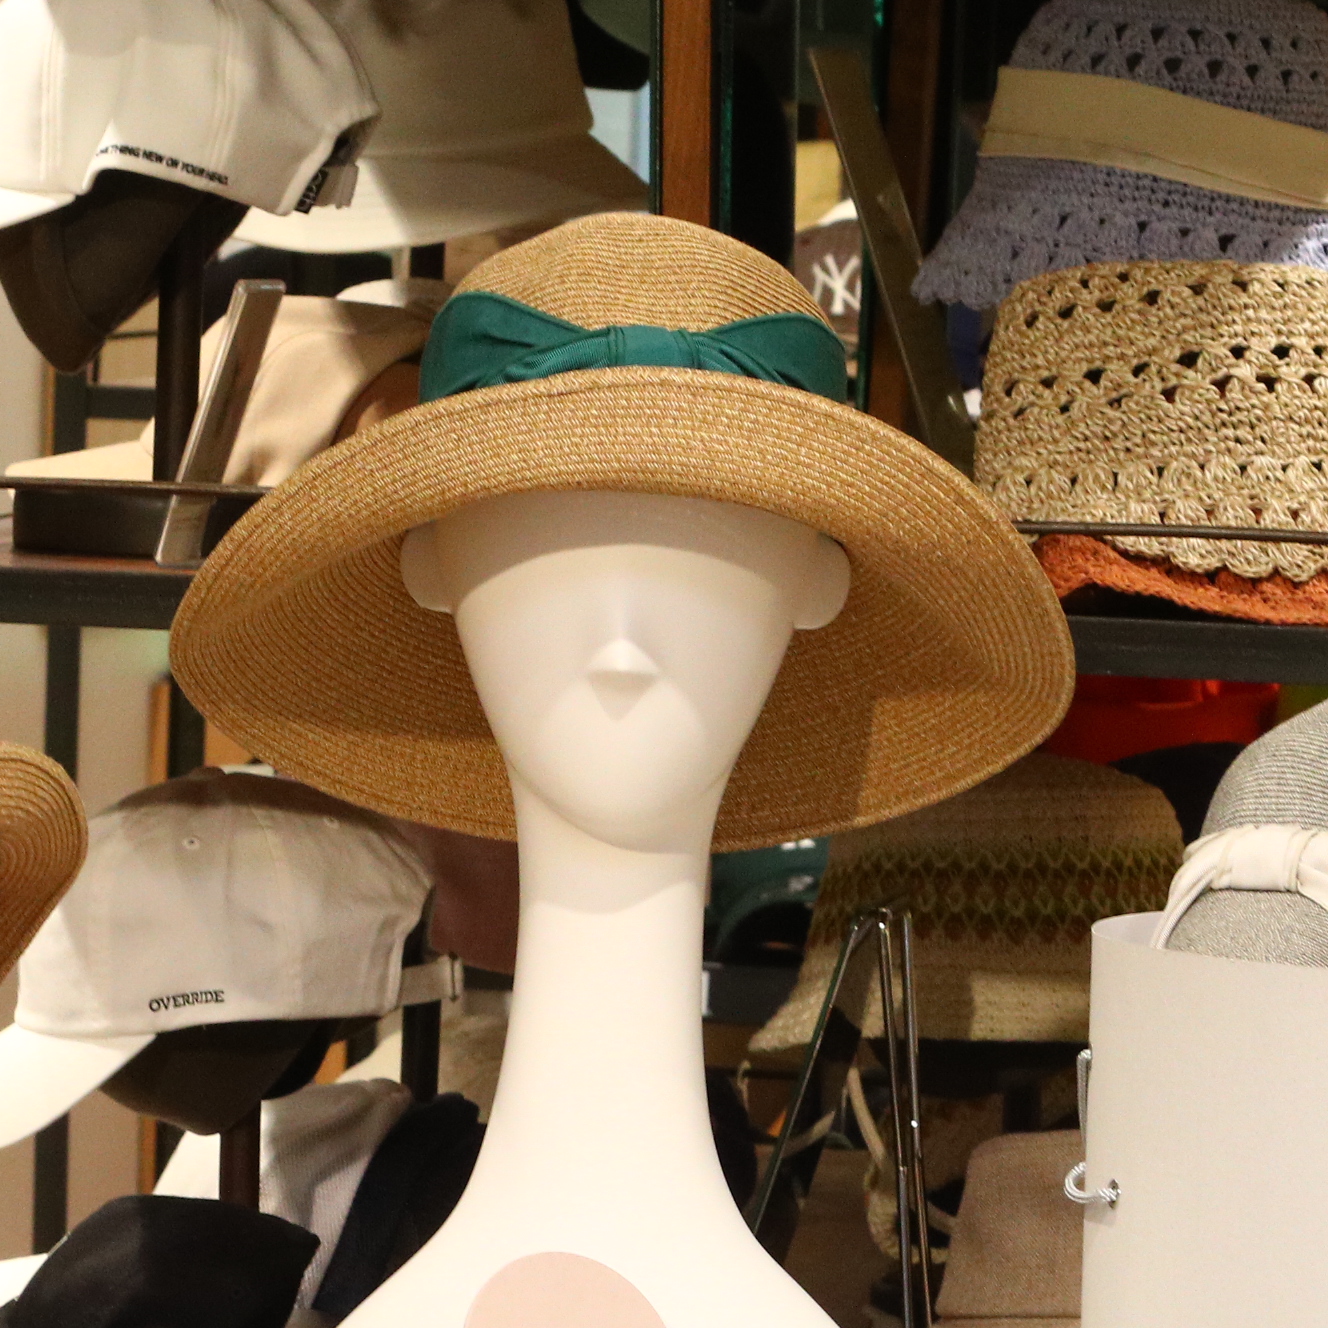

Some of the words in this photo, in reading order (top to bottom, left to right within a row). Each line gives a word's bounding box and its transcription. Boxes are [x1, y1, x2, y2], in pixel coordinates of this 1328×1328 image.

[141, 149, 165, 163] NEW
[812, 253, 861, 315] NY
[149, 990, 225, 1012] OVERRIDE
